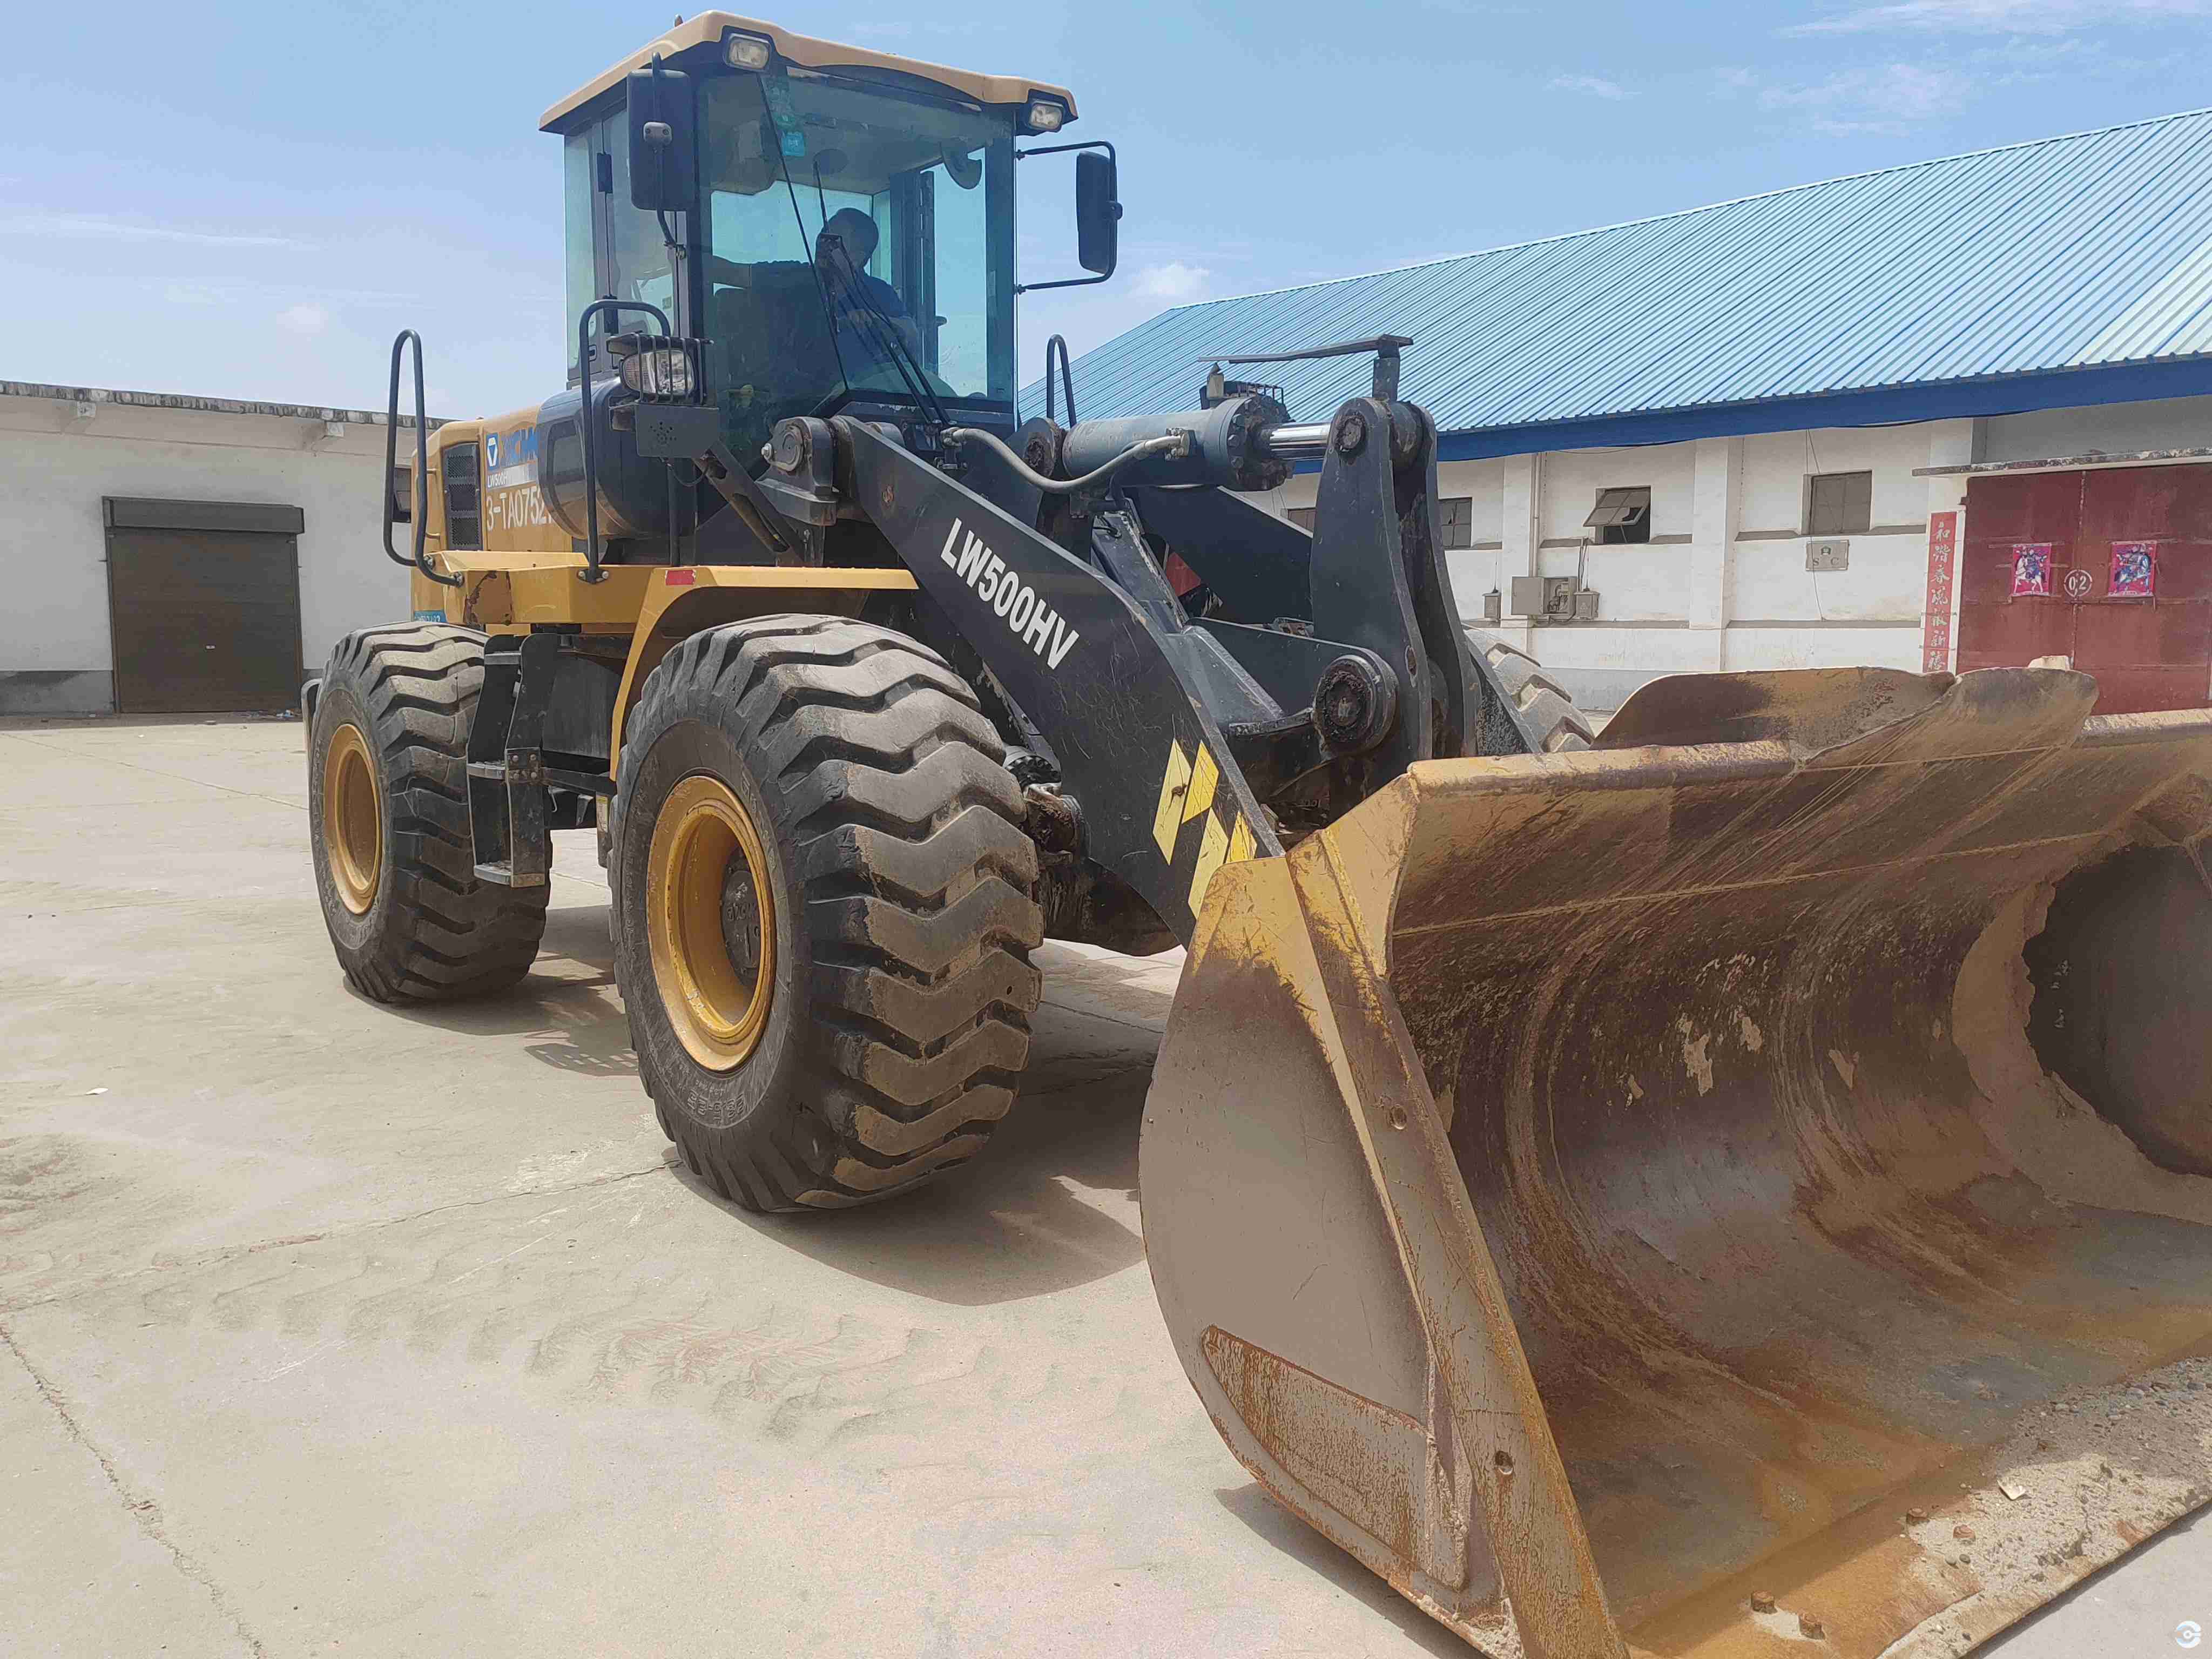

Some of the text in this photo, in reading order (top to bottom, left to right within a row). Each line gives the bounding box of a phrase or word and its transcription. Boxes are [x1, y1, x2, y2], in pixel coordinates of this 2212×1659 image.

[487, 483, 553, 531] 3-TA0752
[941, 517, 1080, 670] LW500HV
[2069, 575, 2087, 591] 02
